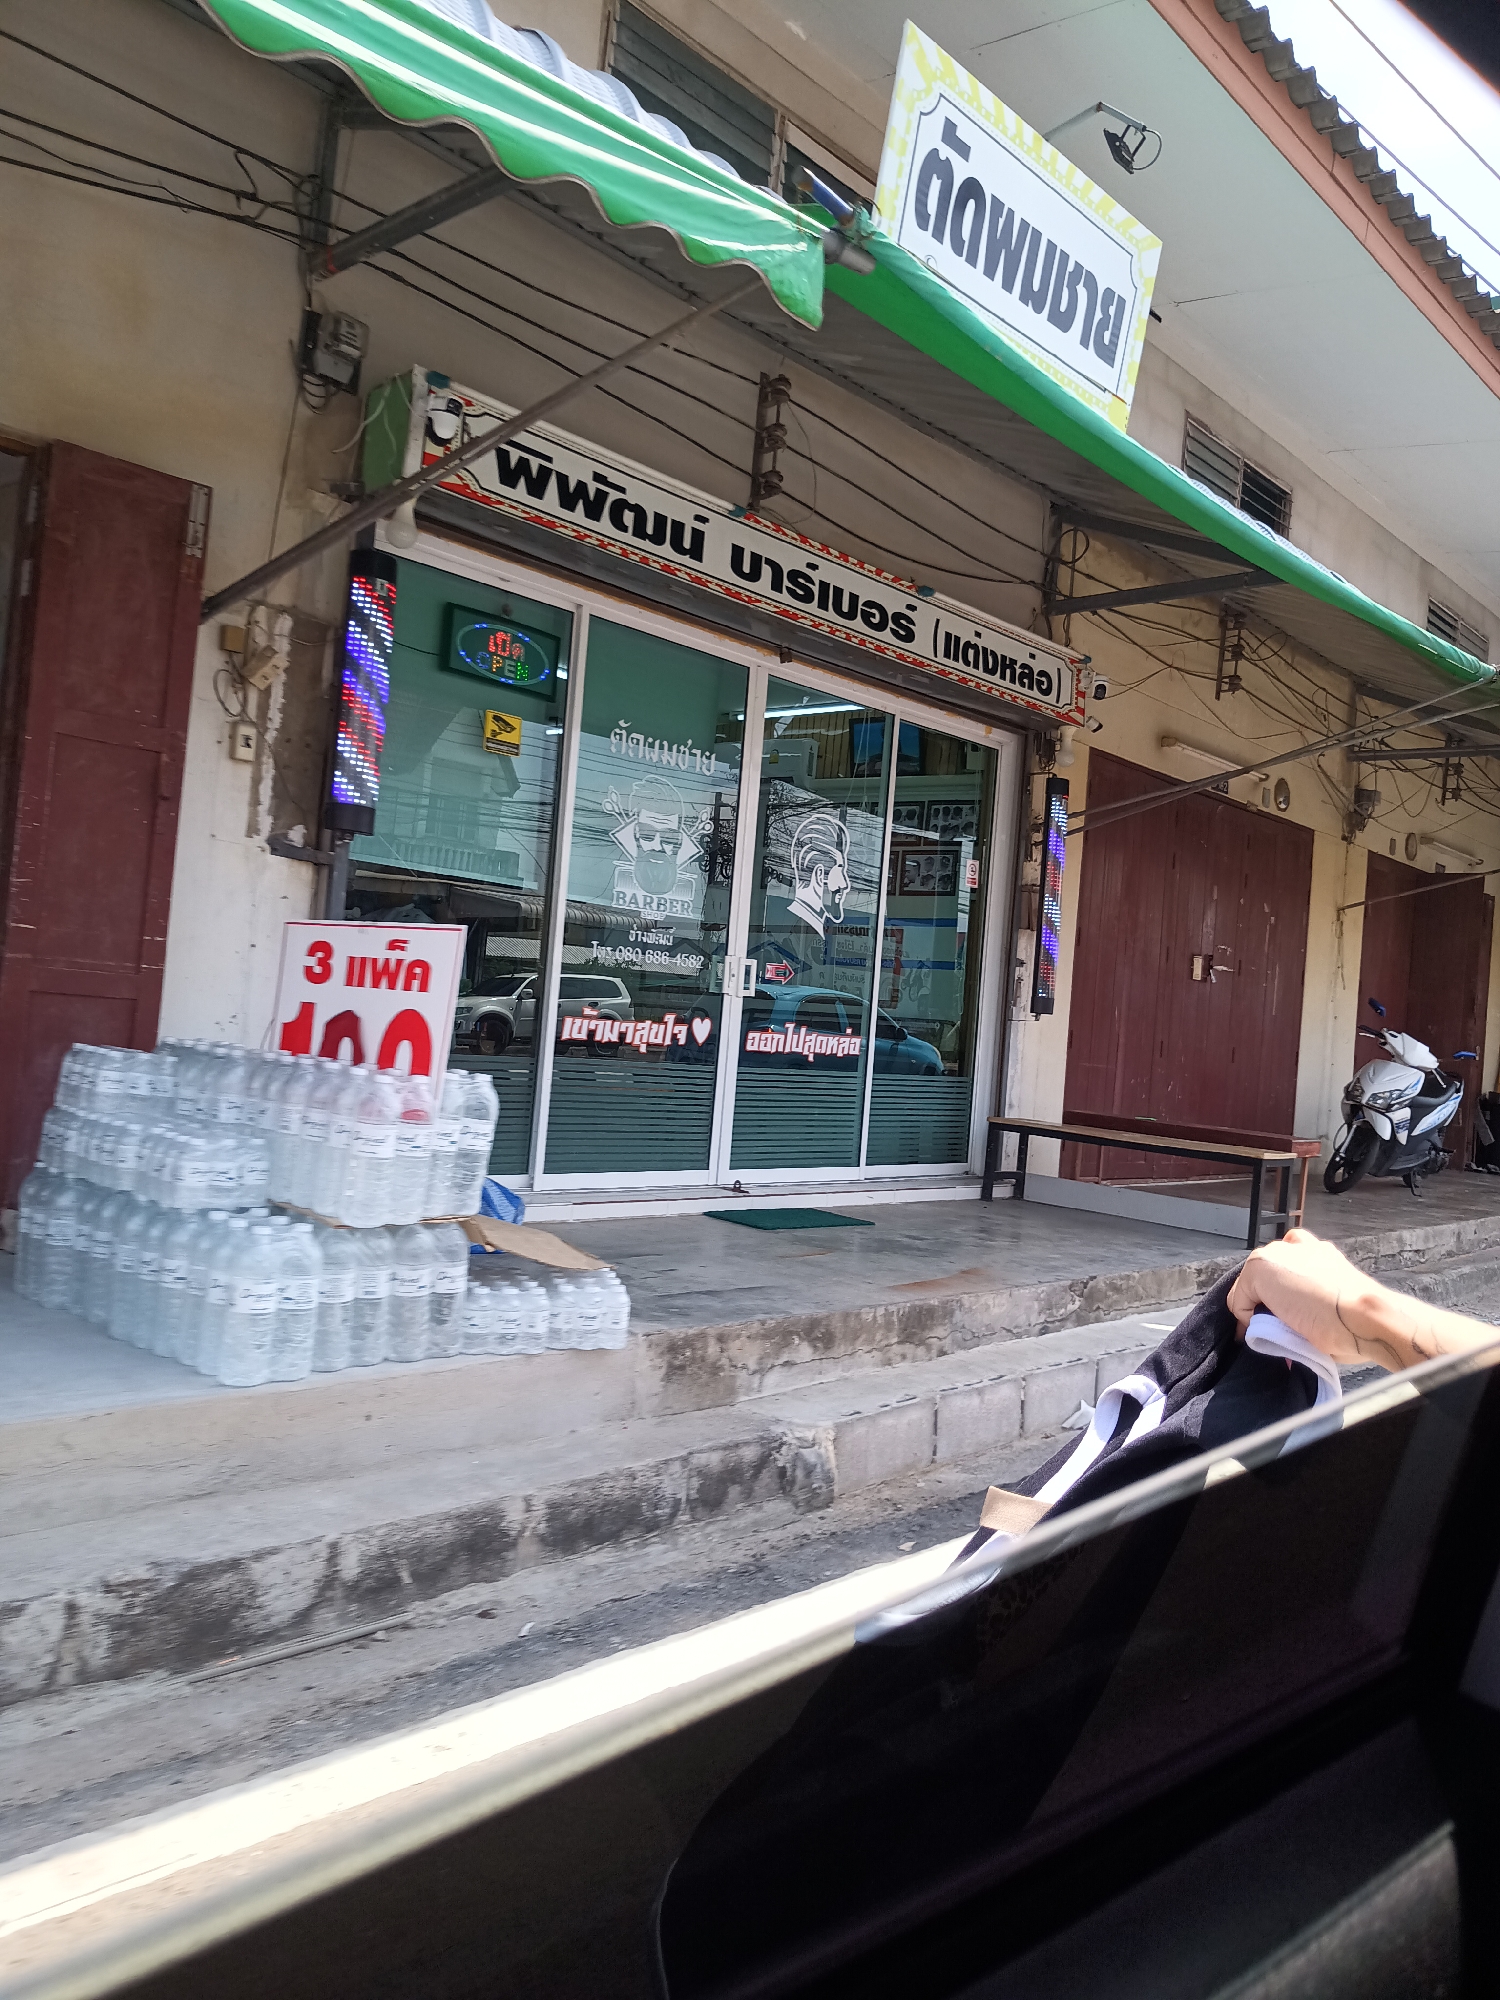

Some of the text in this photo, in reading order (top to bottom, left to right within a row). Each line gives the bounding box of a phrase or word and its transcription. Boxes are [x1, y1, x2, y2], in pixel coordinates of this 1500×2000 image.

[914, 116, 1127, 369] ตัดผมชาย
[495, 437, 1062, 705] พิพัฒน์ บาร์เบอร์ (แต่งหล่อ)
[613, 889, 693, 917] BARBER
[641, 910, 666, 920] SHOP
[303, 938, 433, 993] 3 แพ็ค
[745, 1022, 863, 1063] ออกไปสุดหล่อ
